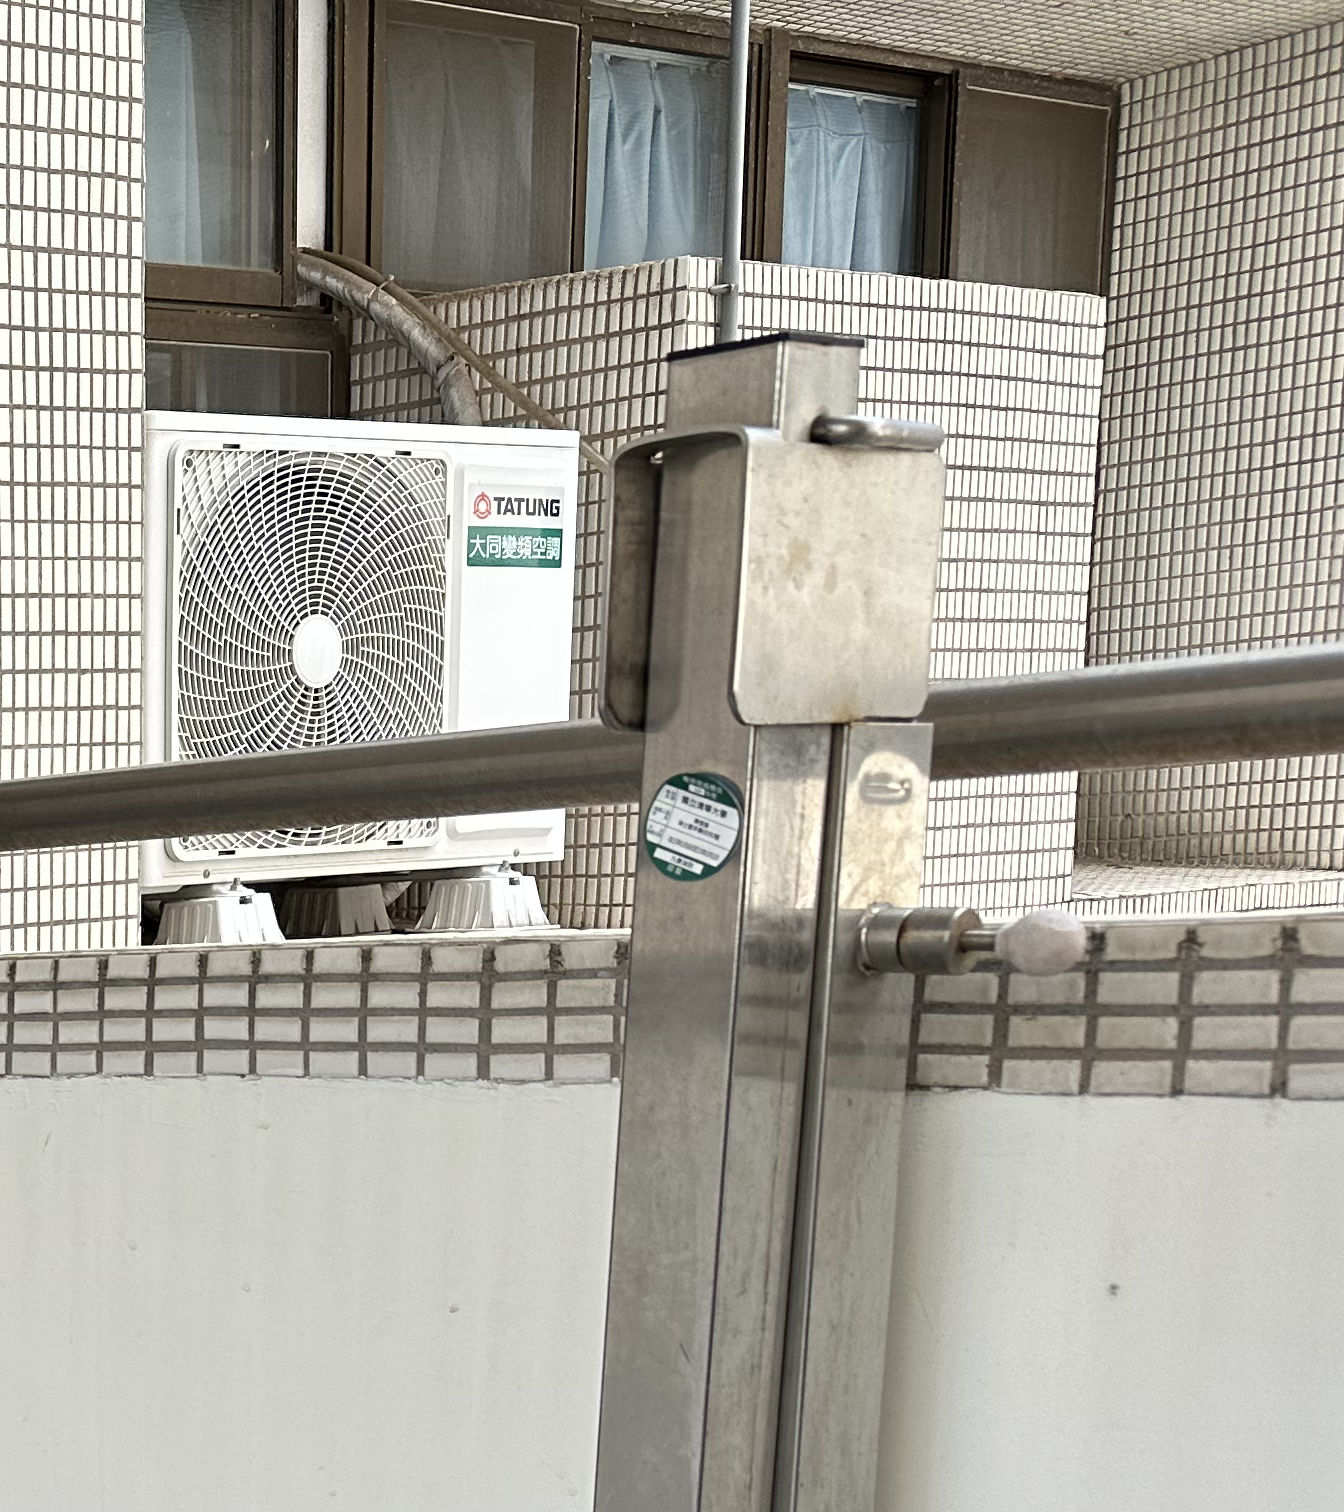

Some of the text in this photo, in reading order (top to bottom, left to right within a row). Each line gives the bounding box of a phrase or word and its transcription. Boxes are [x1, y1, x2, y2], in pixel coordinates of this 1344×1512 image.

[493, 496, 560, 517] TATUNG
[468, 534, 560, 561] 大同變頻空調
